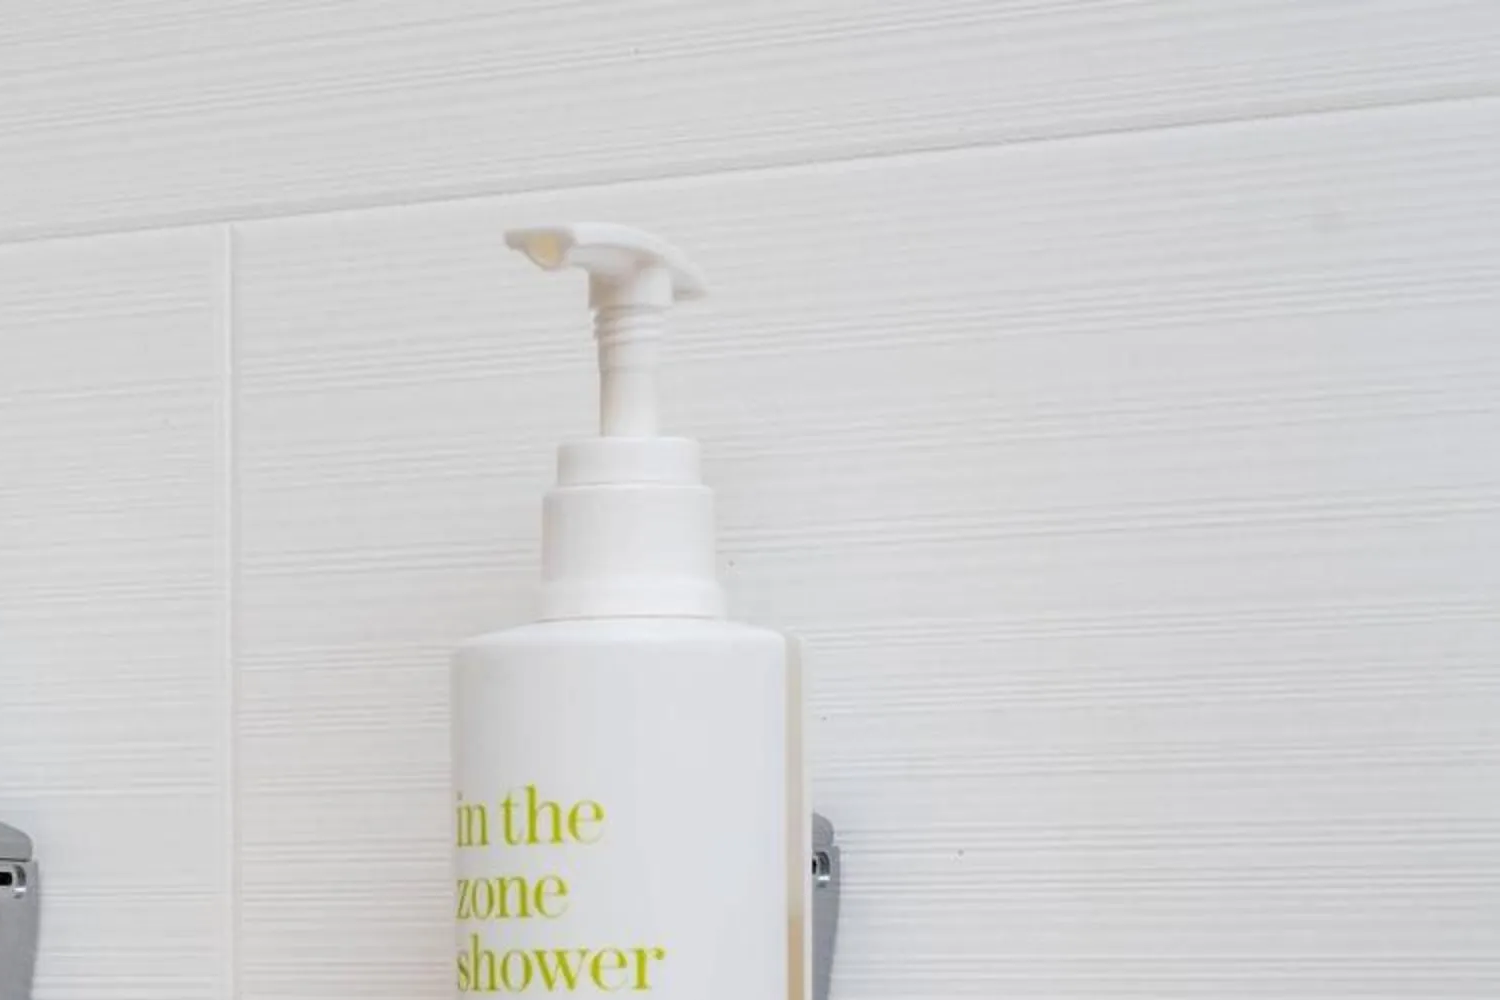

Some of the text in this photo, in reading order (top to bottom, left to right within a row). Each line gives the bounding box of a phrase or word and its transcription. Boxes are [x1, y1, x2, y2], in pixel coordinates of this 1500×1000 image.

[457, 784, 604, 847] in the
[457, 874, 569, 919] zone
[457, 933, 666, 992] shower
